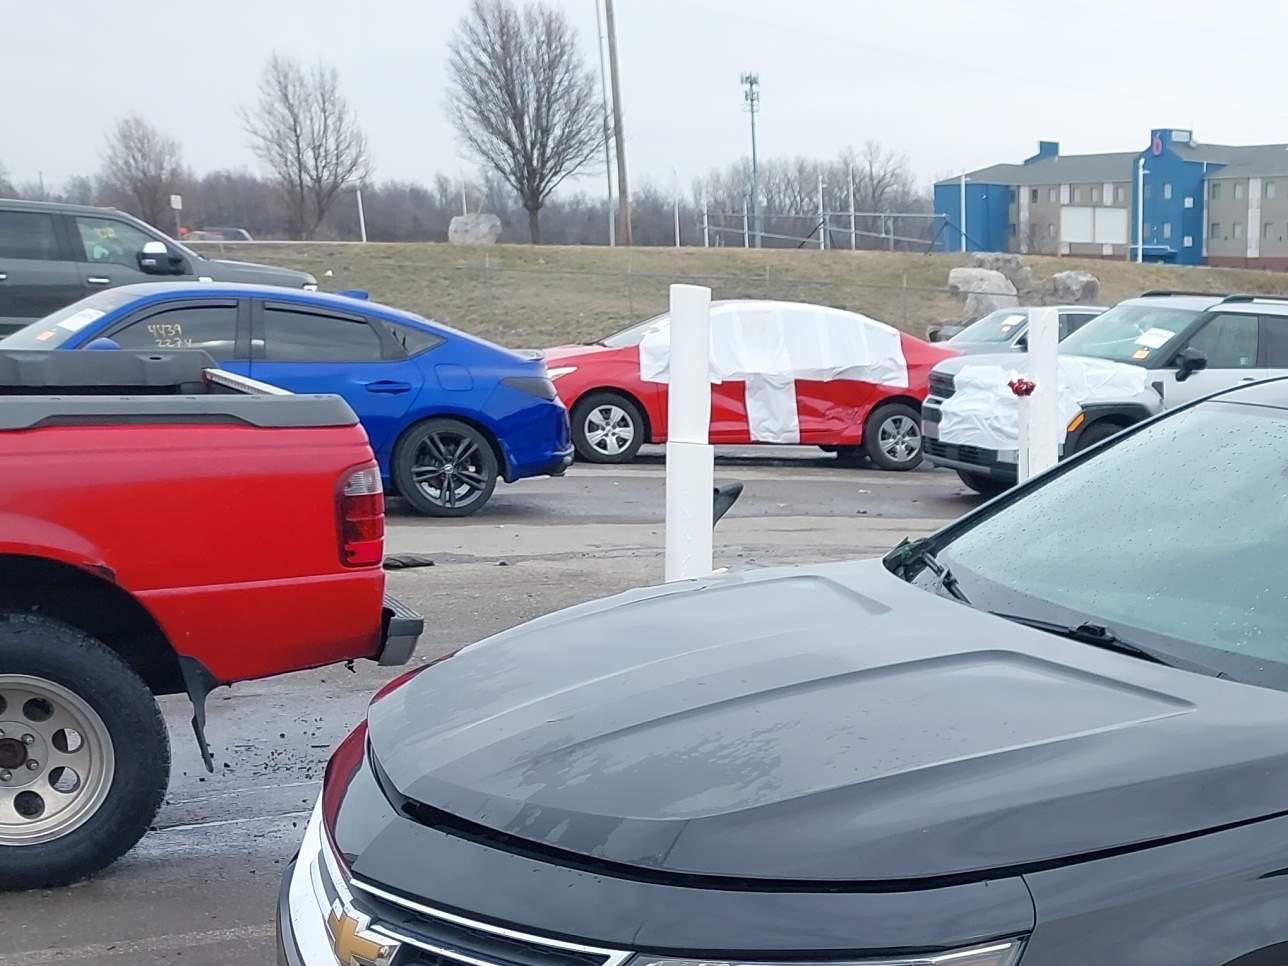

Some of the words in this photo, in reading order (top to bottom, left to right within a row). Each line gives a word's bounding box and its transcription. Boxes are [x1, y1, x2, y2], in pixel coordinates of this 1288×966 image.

[1152, 131, 1163, 156] 6
[147, 323, 182, 338] 4439
[155, 337, 192, 348] 2274
